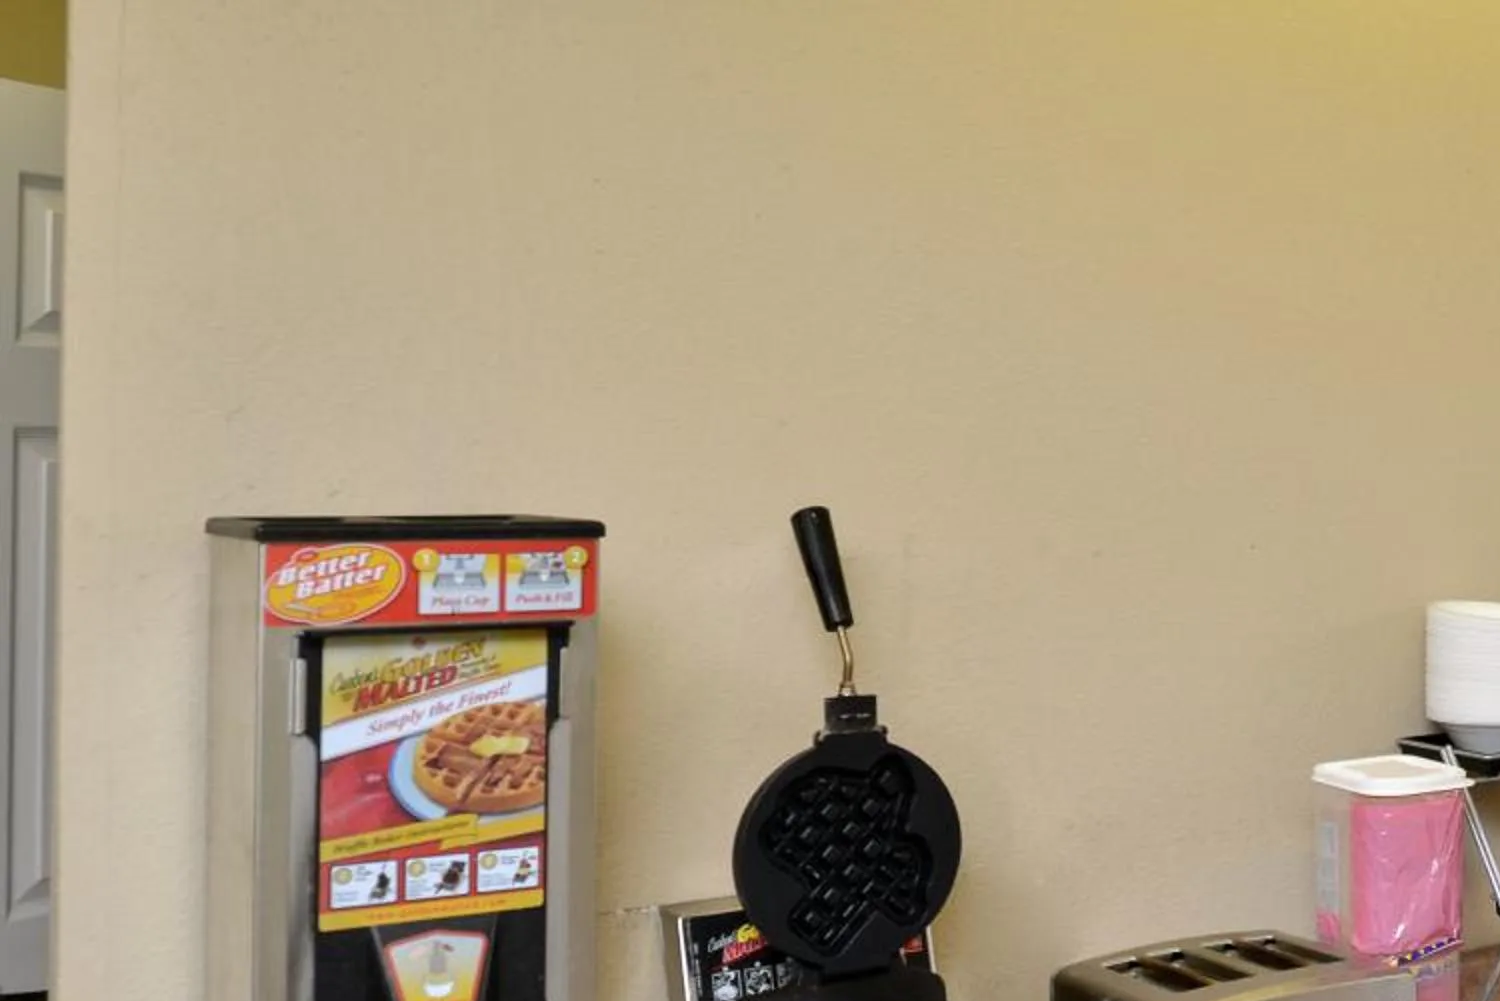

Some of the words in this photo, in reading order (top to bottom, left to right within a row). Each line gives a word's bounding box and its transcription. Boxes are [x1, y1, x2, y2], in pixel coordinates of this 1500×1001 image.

[278, 551, 371, 586] Better
[296, 564, 386, 599] Batter
[379, 636, 487, 683] GOLDEN
[353, 664, 459, 712] MALTED
